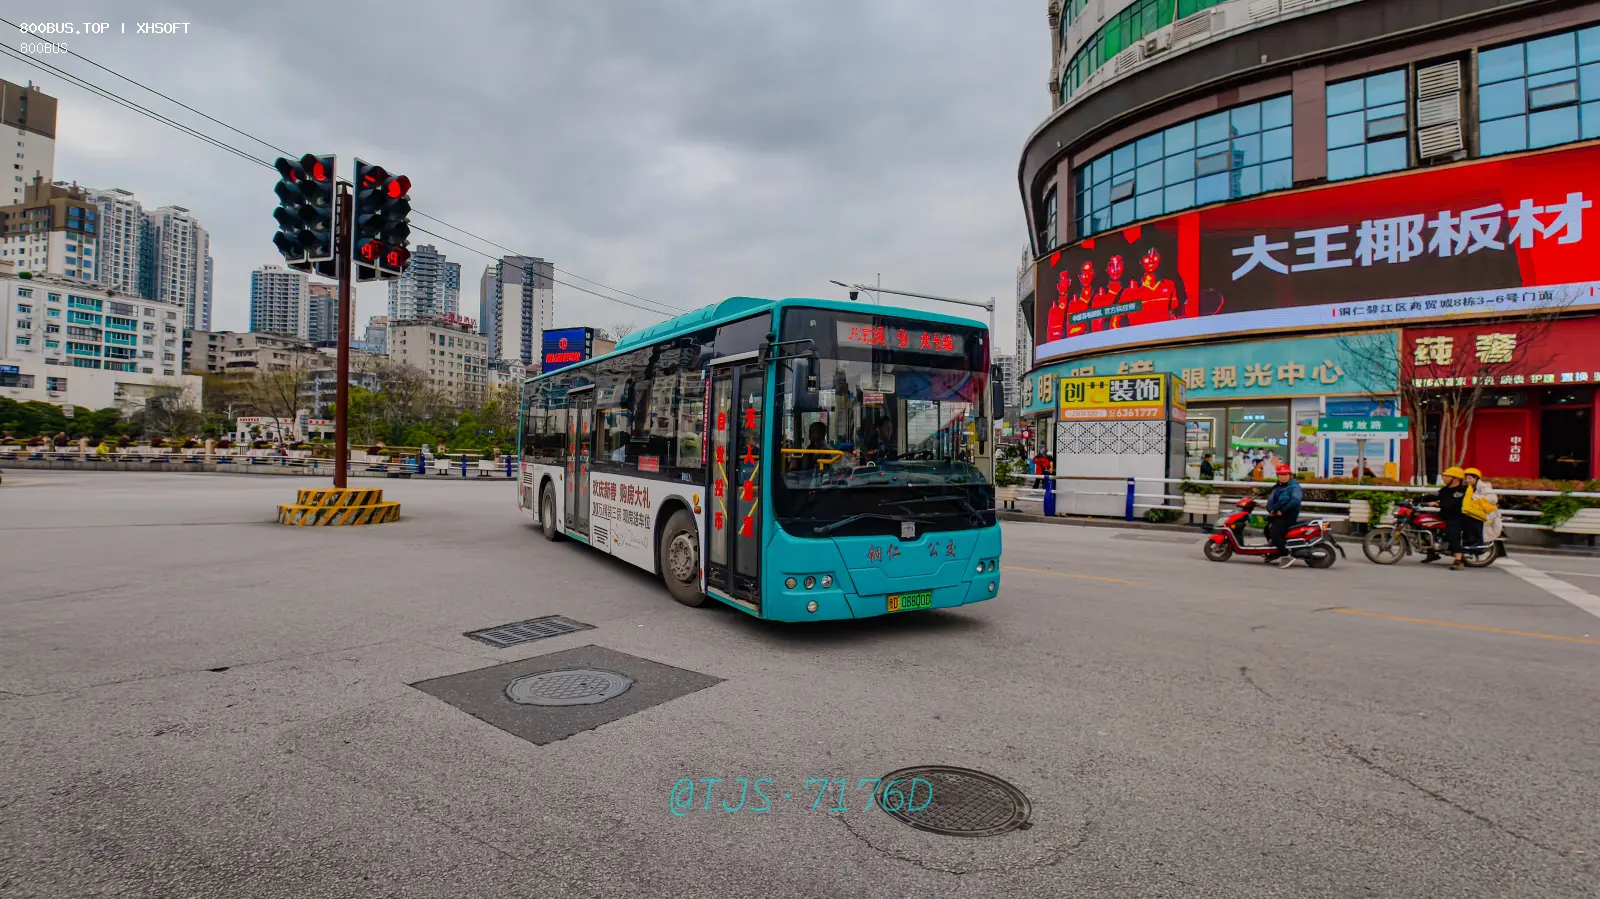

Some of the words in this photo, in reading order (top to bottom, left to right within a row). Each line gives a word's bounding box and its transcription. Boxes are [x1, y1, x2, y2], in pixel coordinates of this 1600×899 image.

[1232, 191, 1592, 281] 大王椰板材
[897, 328, 908, 348] 9
[1182, 359, 1344, 391] 眼视光中心
[1065, 378, 1160, 404] 创艺装饰
[1116, 408, 1159, 417] 6361777
[1342, 420, 1382, 430] 解放路
[1509, 436, 1522, 462] 中古店
[714, 411, 727, 531] 自觉投币
[593, 480, 617, 502] 欢庆新春
[620, 483, 651, 509] 购房大礼
[868, 543, 901, 562] 铜仁
[928, 539, 957, 558] 公交
